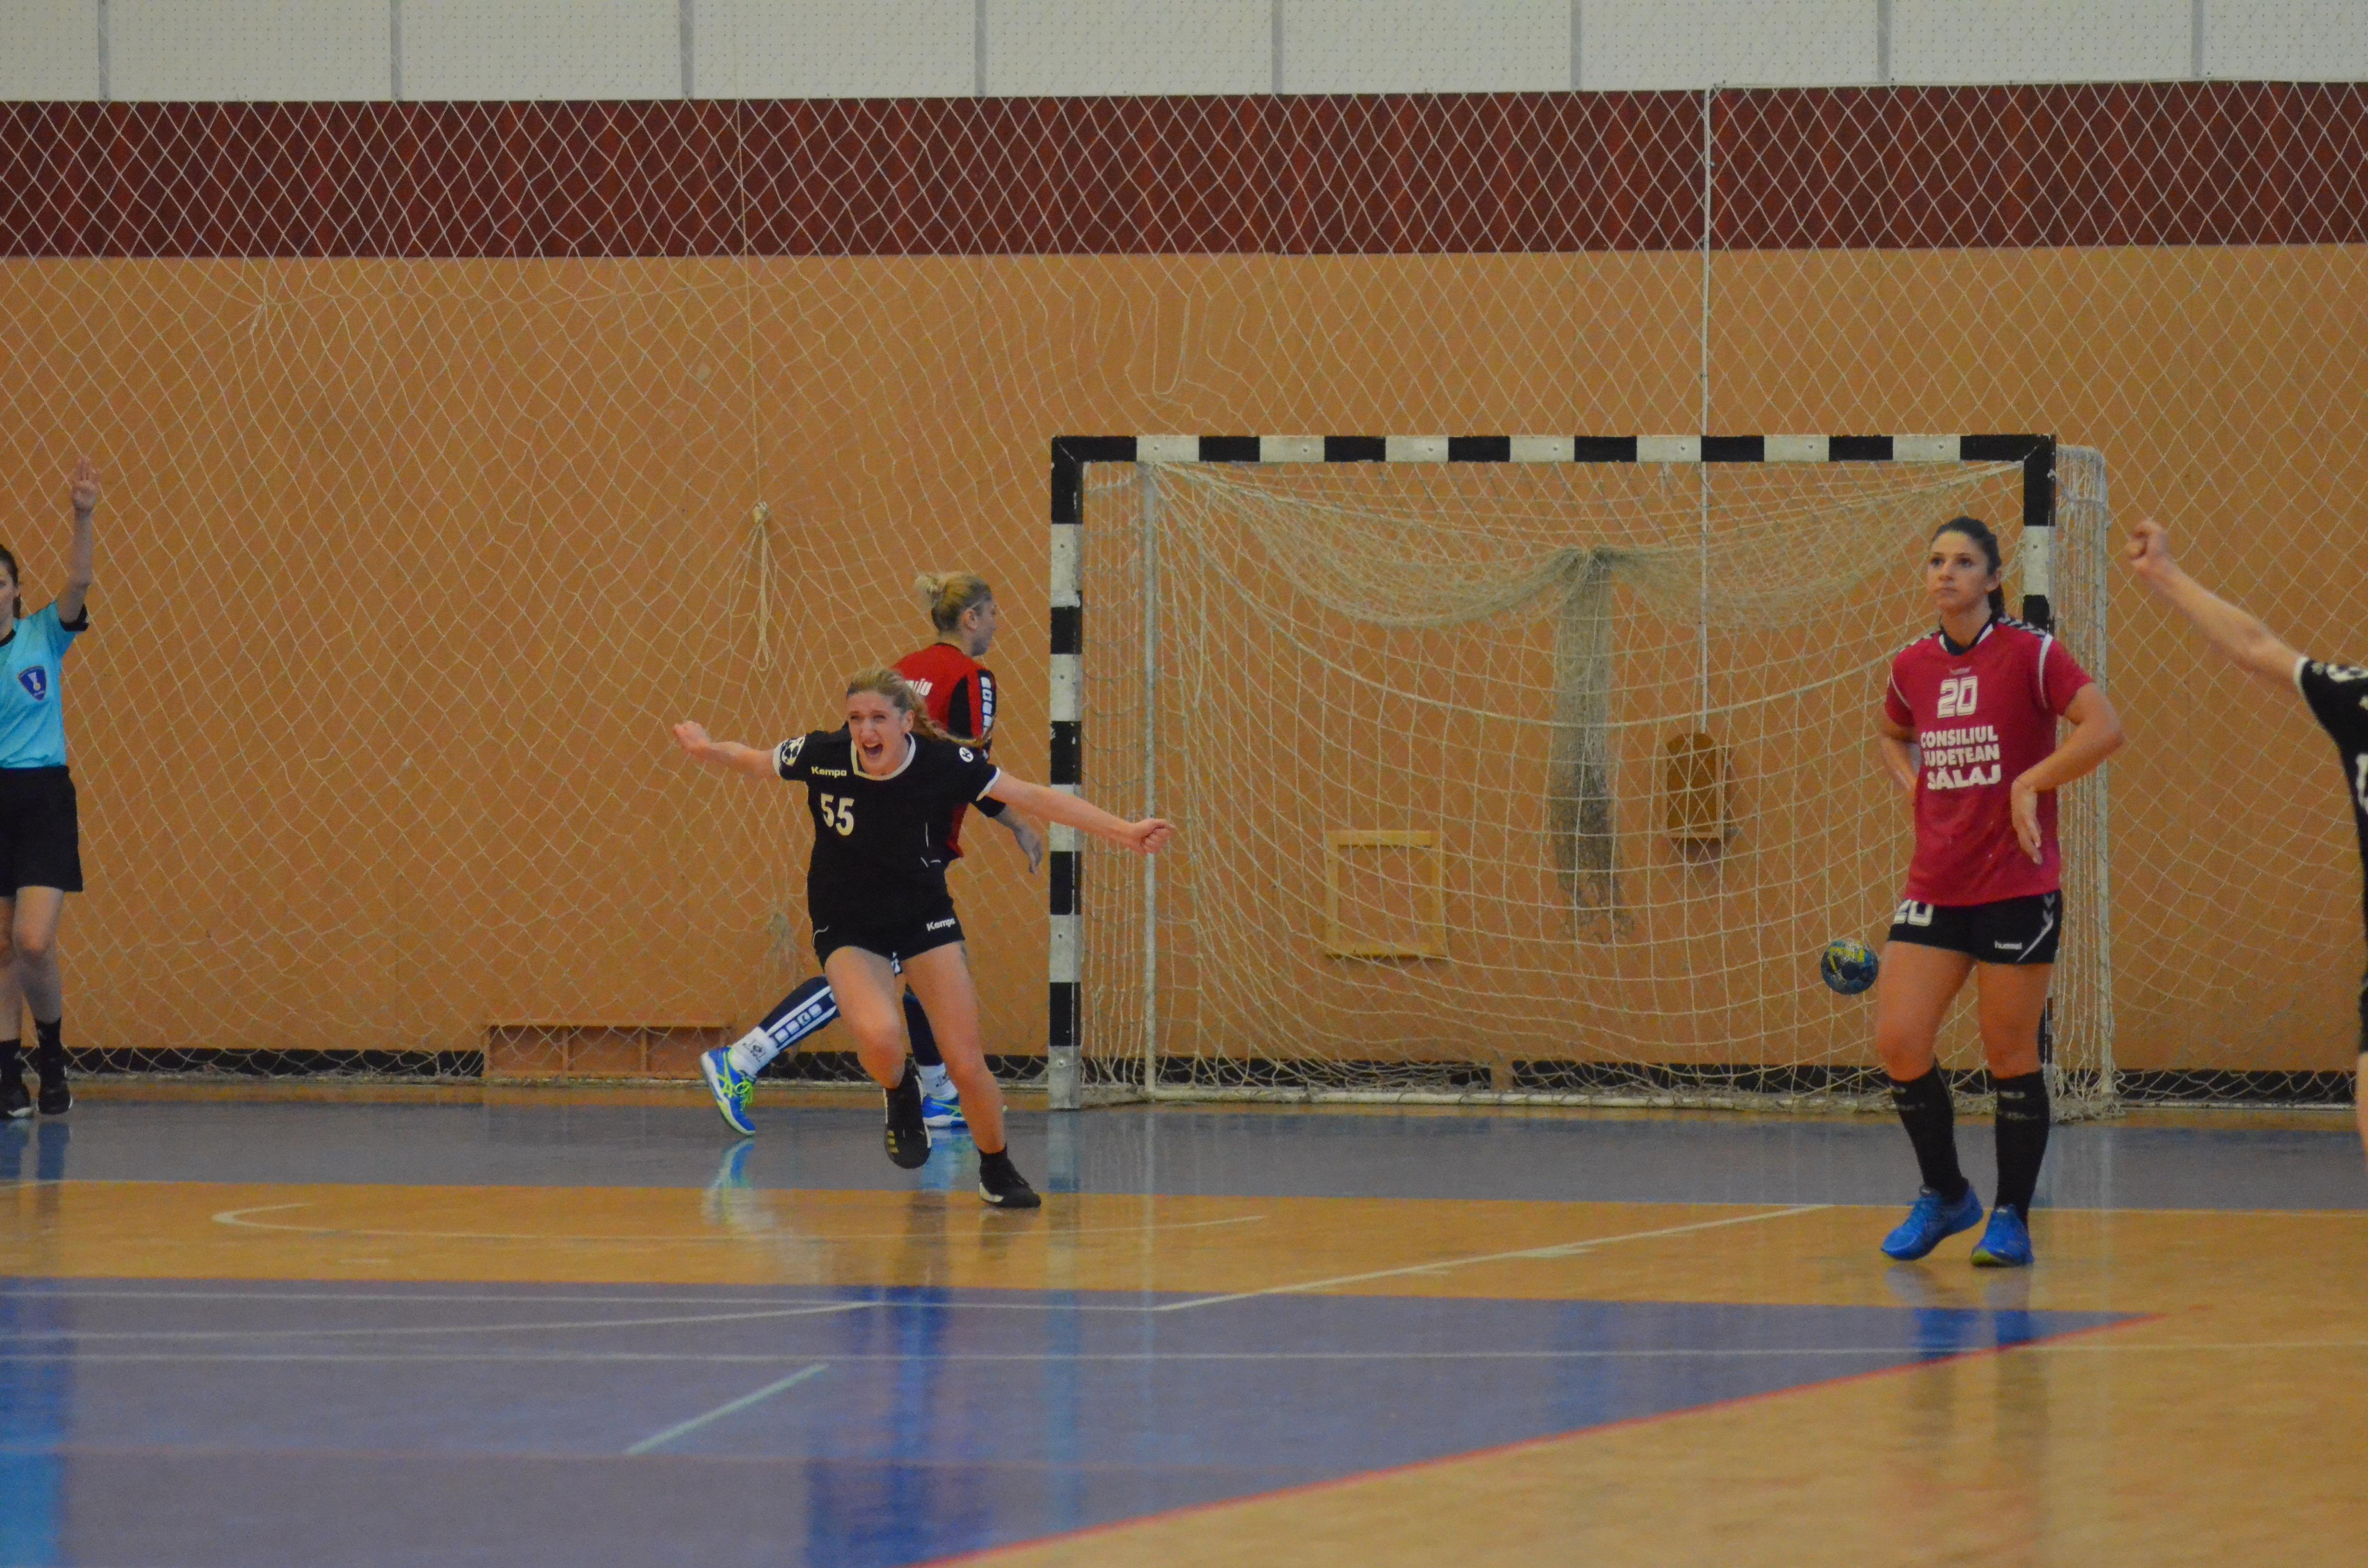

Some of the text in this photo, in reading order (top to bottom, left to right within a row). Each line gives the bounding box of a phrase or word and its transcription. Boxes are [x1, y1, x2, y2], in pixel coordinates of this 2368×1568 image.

[1937, 676, 1978, 719] 20
[1921, 725, 1998, 749] CONSILIUL
[811, 766, 847, 779] Kempa
[821, 793, 854, 836] 55
